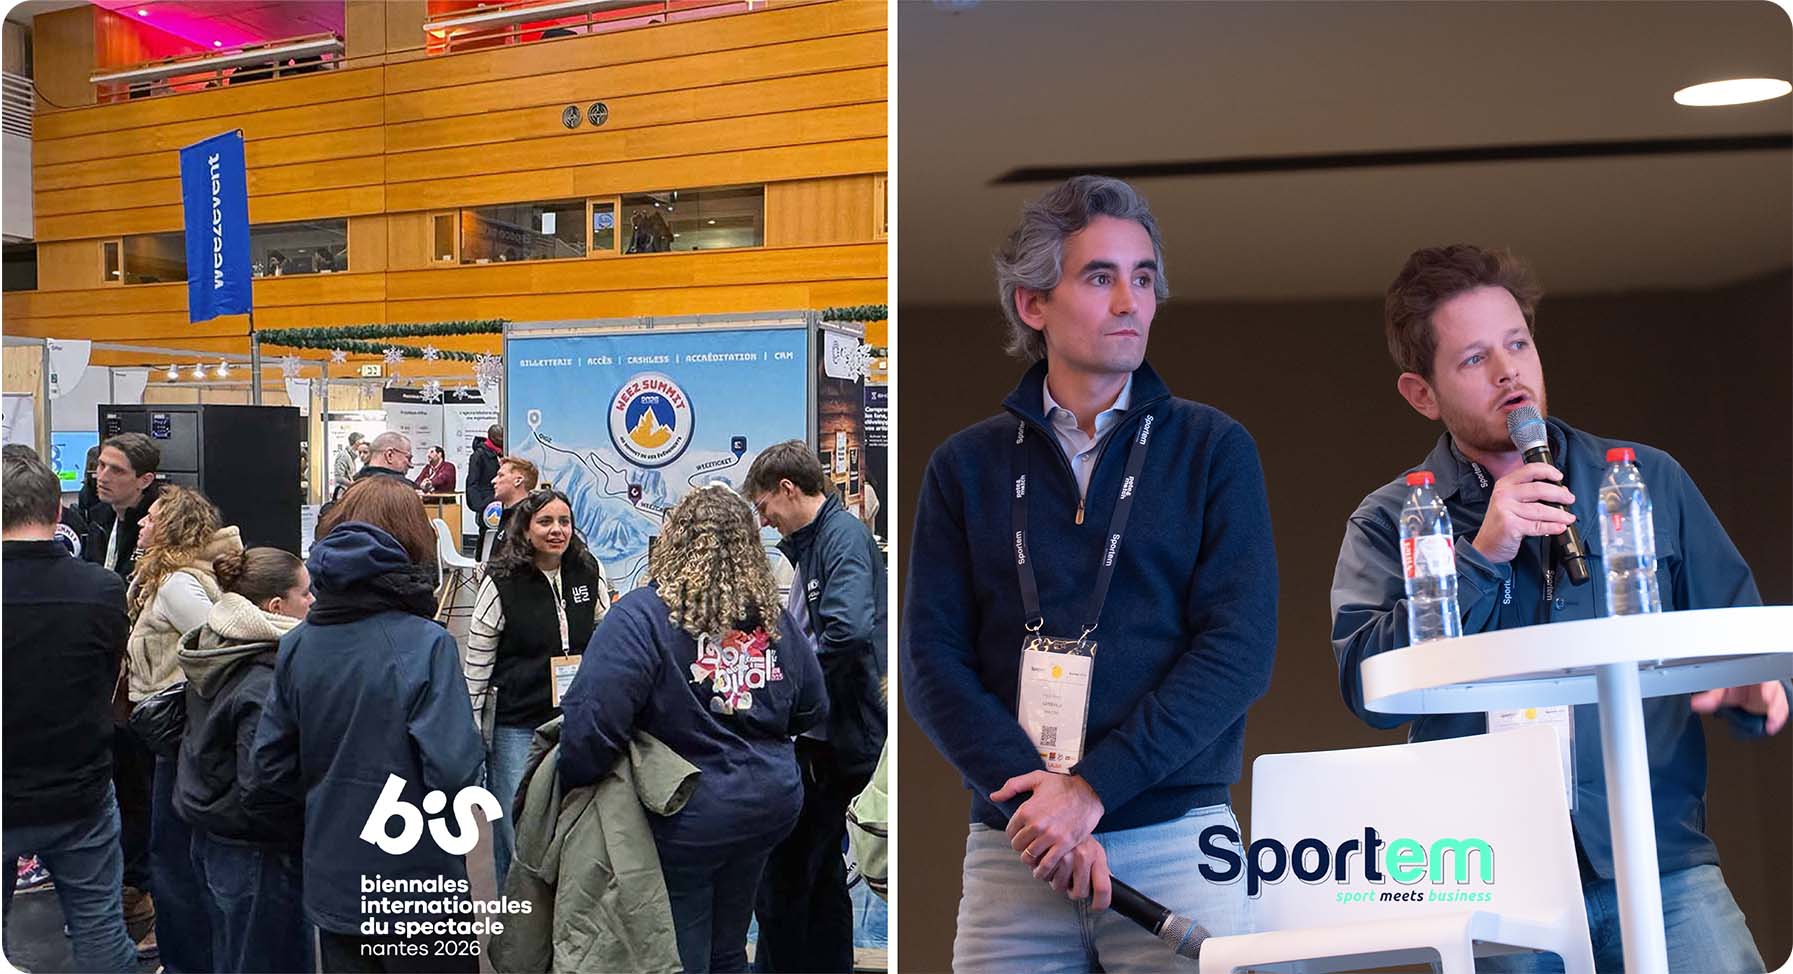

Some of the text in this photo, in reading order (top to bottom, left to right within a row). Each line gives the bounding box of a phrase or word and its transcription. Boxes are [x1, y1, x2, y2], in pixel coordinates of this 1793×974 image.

[208, 152, 224, 290] weezevent
[520, 358, 572, 367] BILLETTERIE
[587, 355, 613, 366] ACCÈS
[627, 355, 670, 364] CASHLESS
[774, 351, 794, 360] CRM
[616, 380, 686, 411] WEEZ SUMMIT
[1139, 414, 1154, 445] Sportem
[696, 458, 732, 470] WEEZTICKET
[1016, 530, 1026, 565] Sportem
[1105, 533, 1121, 567] Sportem
